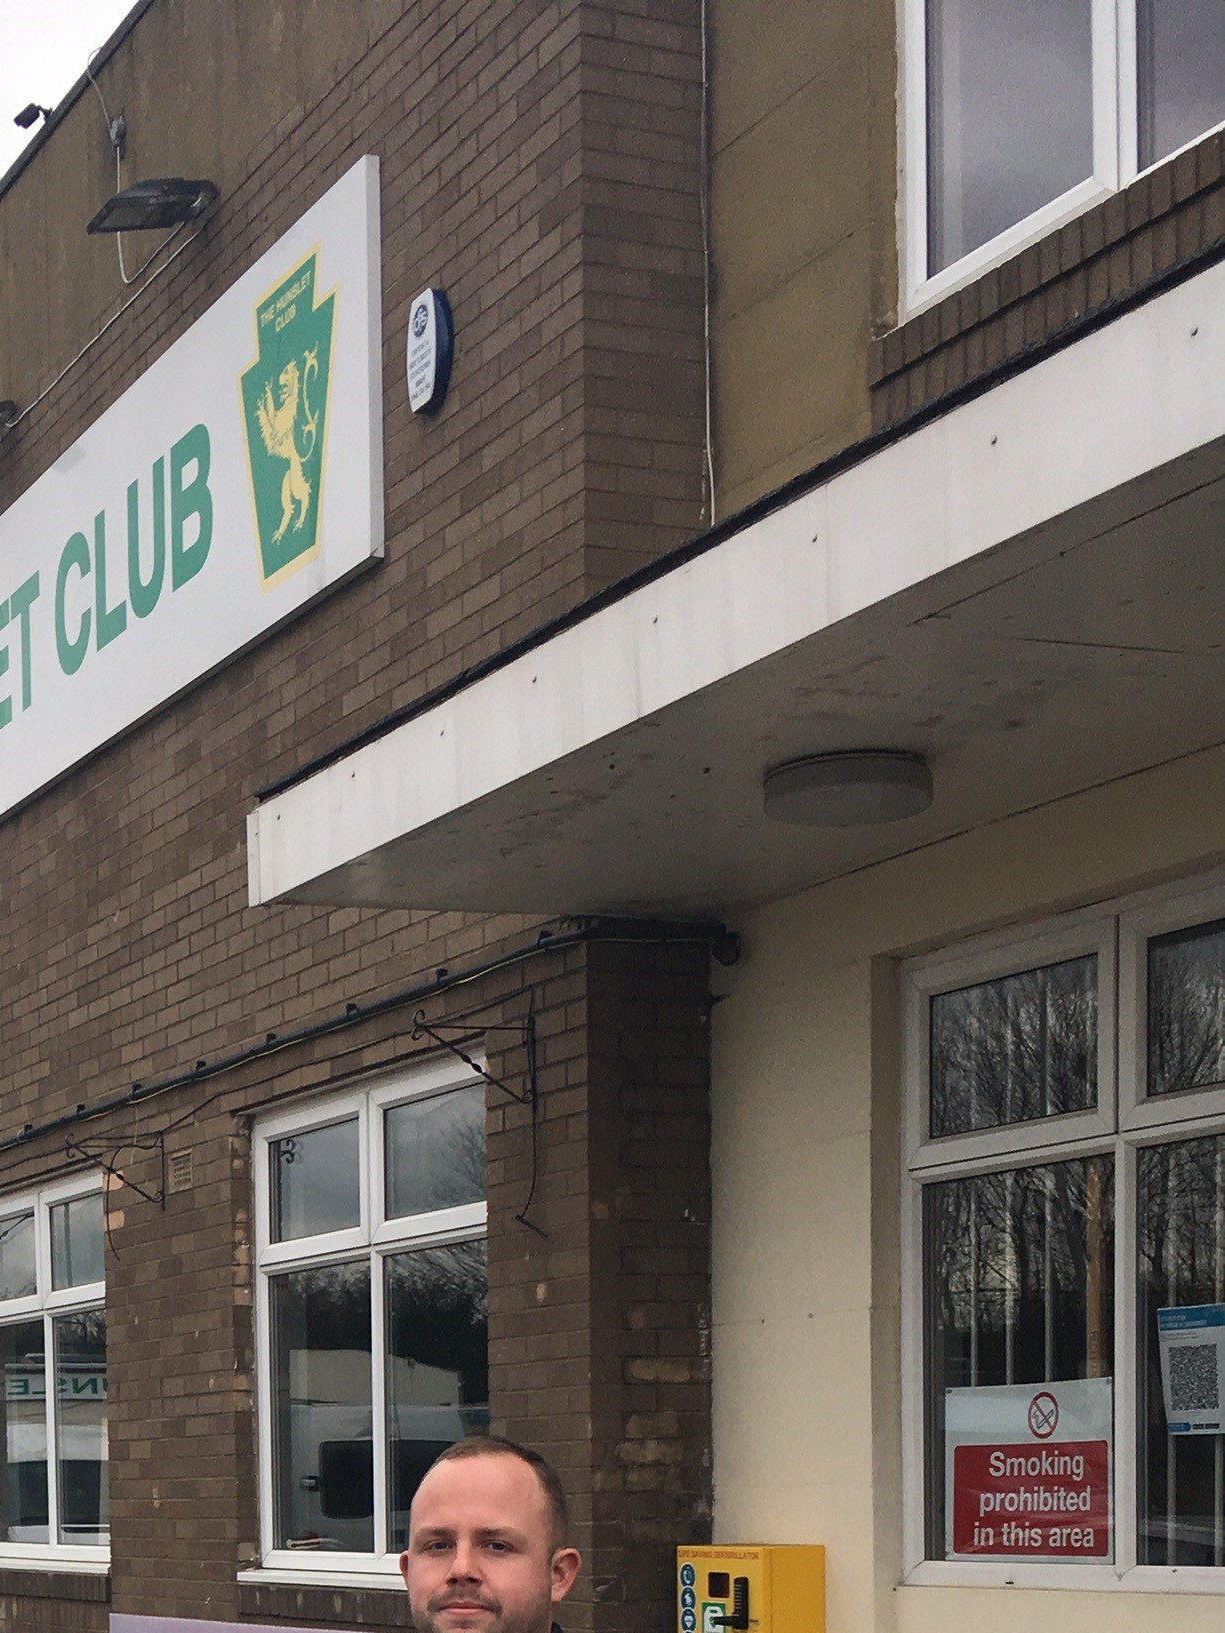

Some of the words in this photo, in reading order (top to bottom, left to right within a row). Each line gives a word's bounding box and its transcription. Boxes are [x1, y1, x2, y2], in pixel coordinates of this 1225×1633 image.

[275, 303, 296, 333] CLUB
[55, 423, 213, 676] CLUB
[988, 1450, 1084, 1481] Smoking
[979, 1485, 1091, 1517] prohibited
[973, 1521, 994, 1547] in
[1001, 1521, 1042, 1547] this
[1048, 1526, 1095, 1548] area
